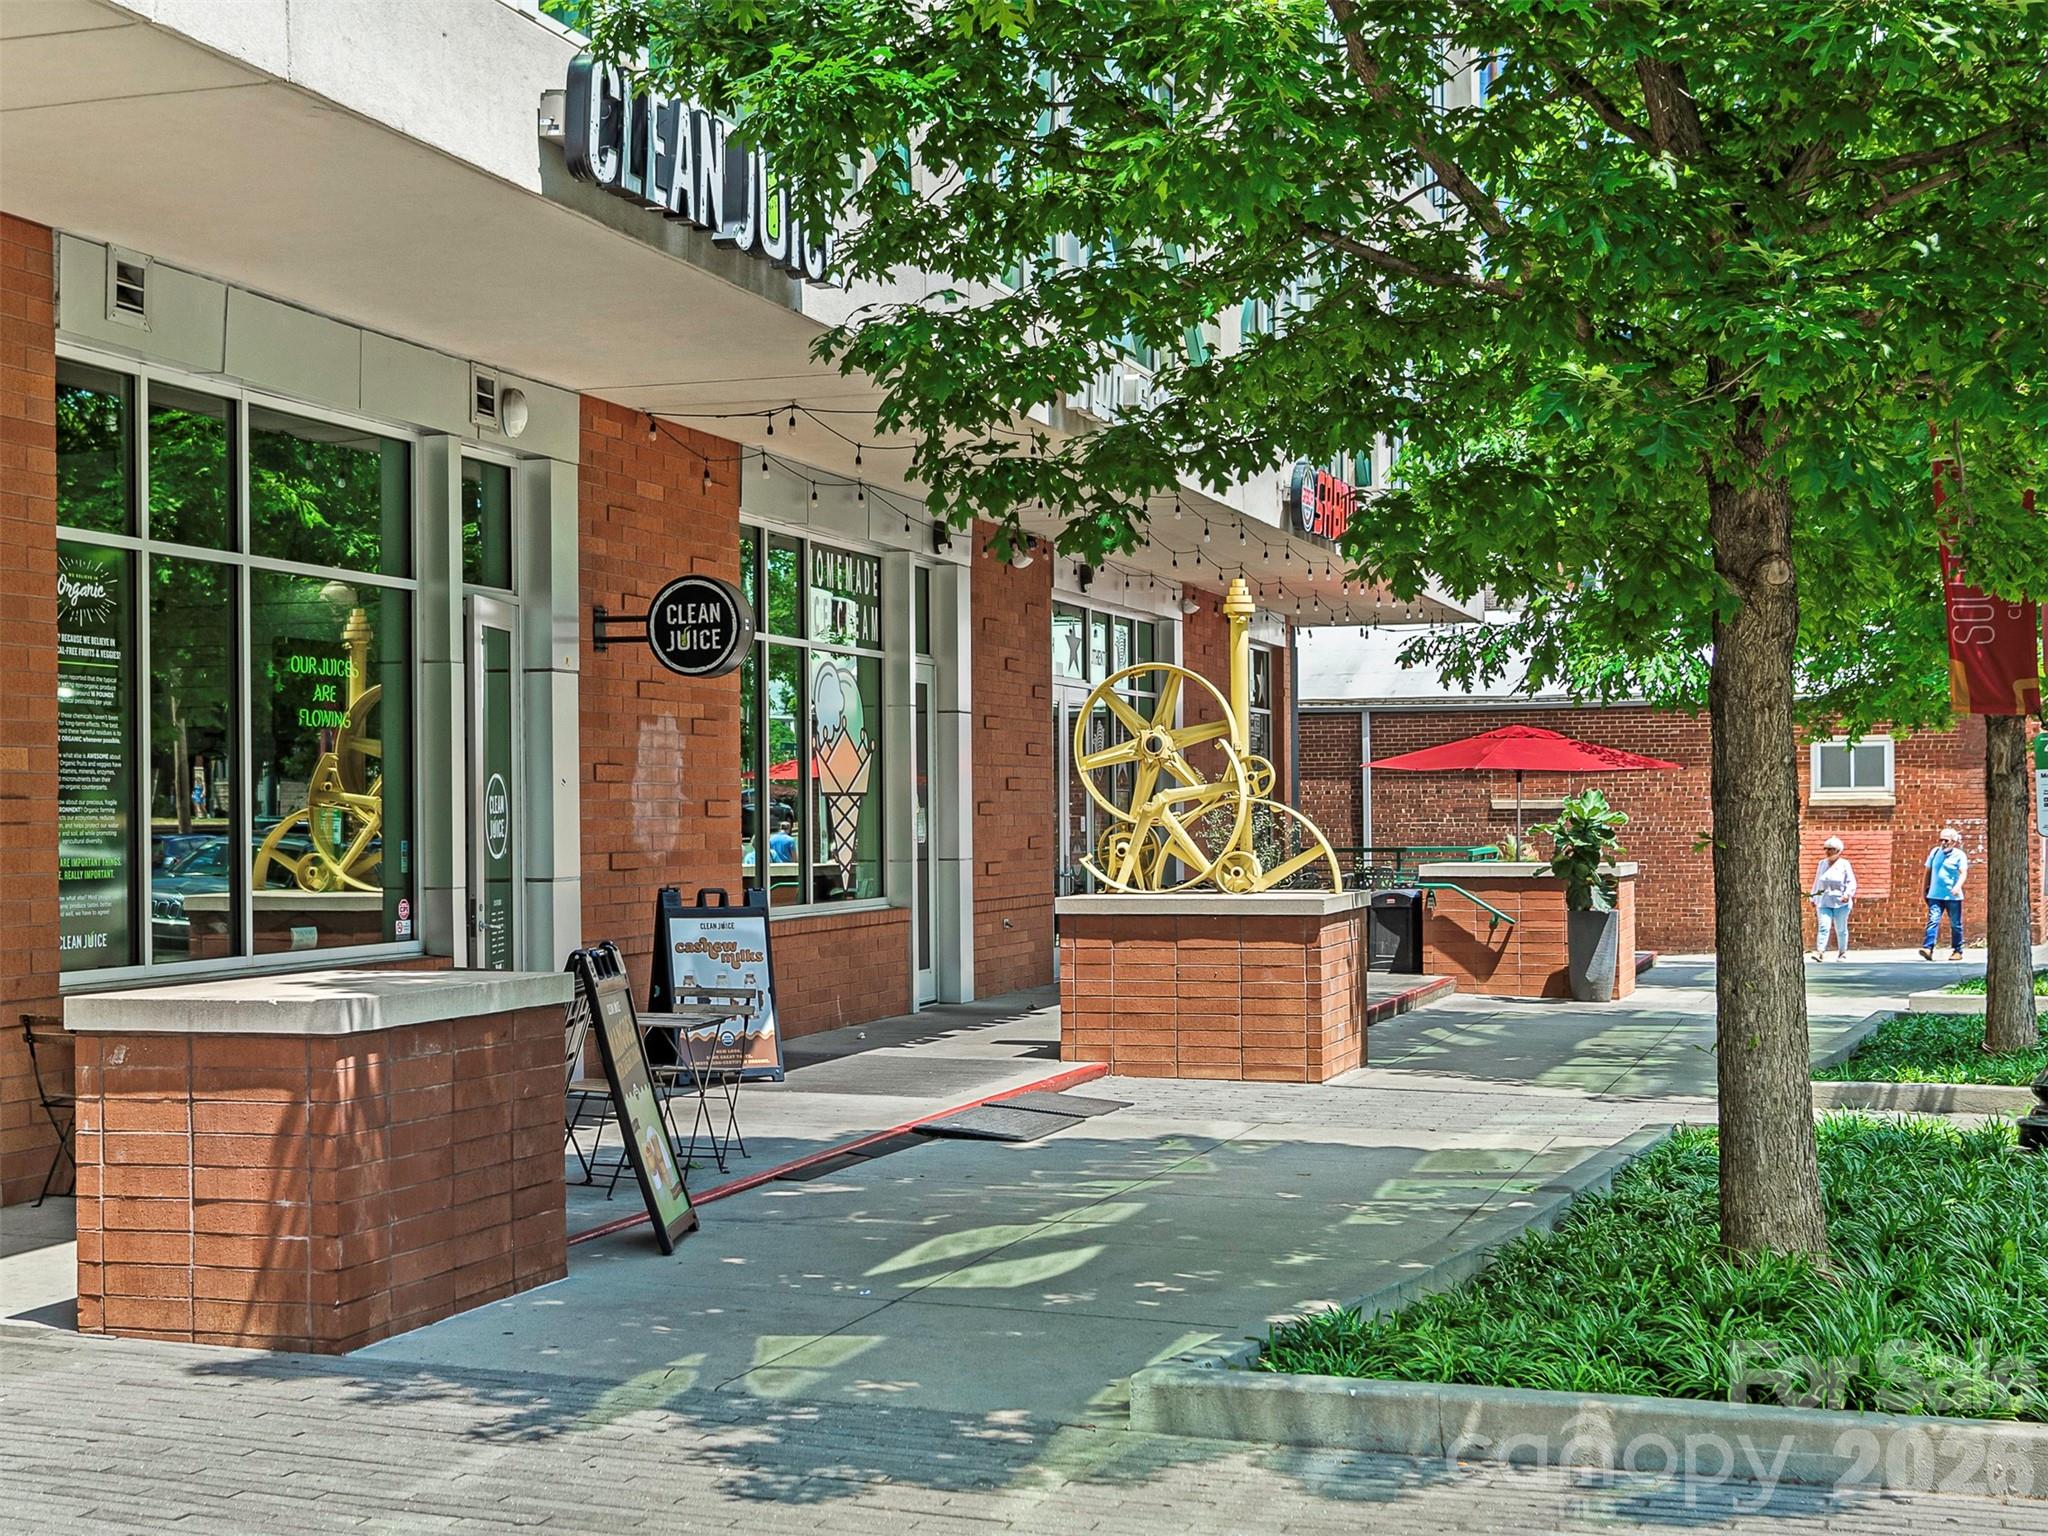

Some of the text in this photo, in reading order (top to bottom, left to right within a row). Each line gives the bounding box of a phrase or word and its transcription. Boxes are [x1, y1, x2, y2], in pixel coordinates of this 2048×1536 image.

[586, 54, 725, 233] CLEAN
[810, 548, 878, 597] OMEMADE
[58, 573, 106, 606] Organic
[666, 602, 720, 625] CLEAN
[61, 633, 82, 644] BECAUSE
[83, 636, 90, 645] WE
[91, 637, 109, 646] BELIEVE
[110, 638, 116, 647] IN
[666, 625, 722, 652] JUICE
[79, 648, 94, 657] FRUITS
[290, 656, 360, 678] OUR JUICES
[312, 684, 336, 702] ARE
[299, 708, 352, 728] FLOWING
[490, 795, 504, 815] CLEAN
[490, 817, 504, 840] JUICE
[700, 922, 735, 930] CLEAN JUICE
[83, 931, 108, 949] JUICE
[674, 936, 738, 960] cashew
[721, 949, 764, 970] milks
